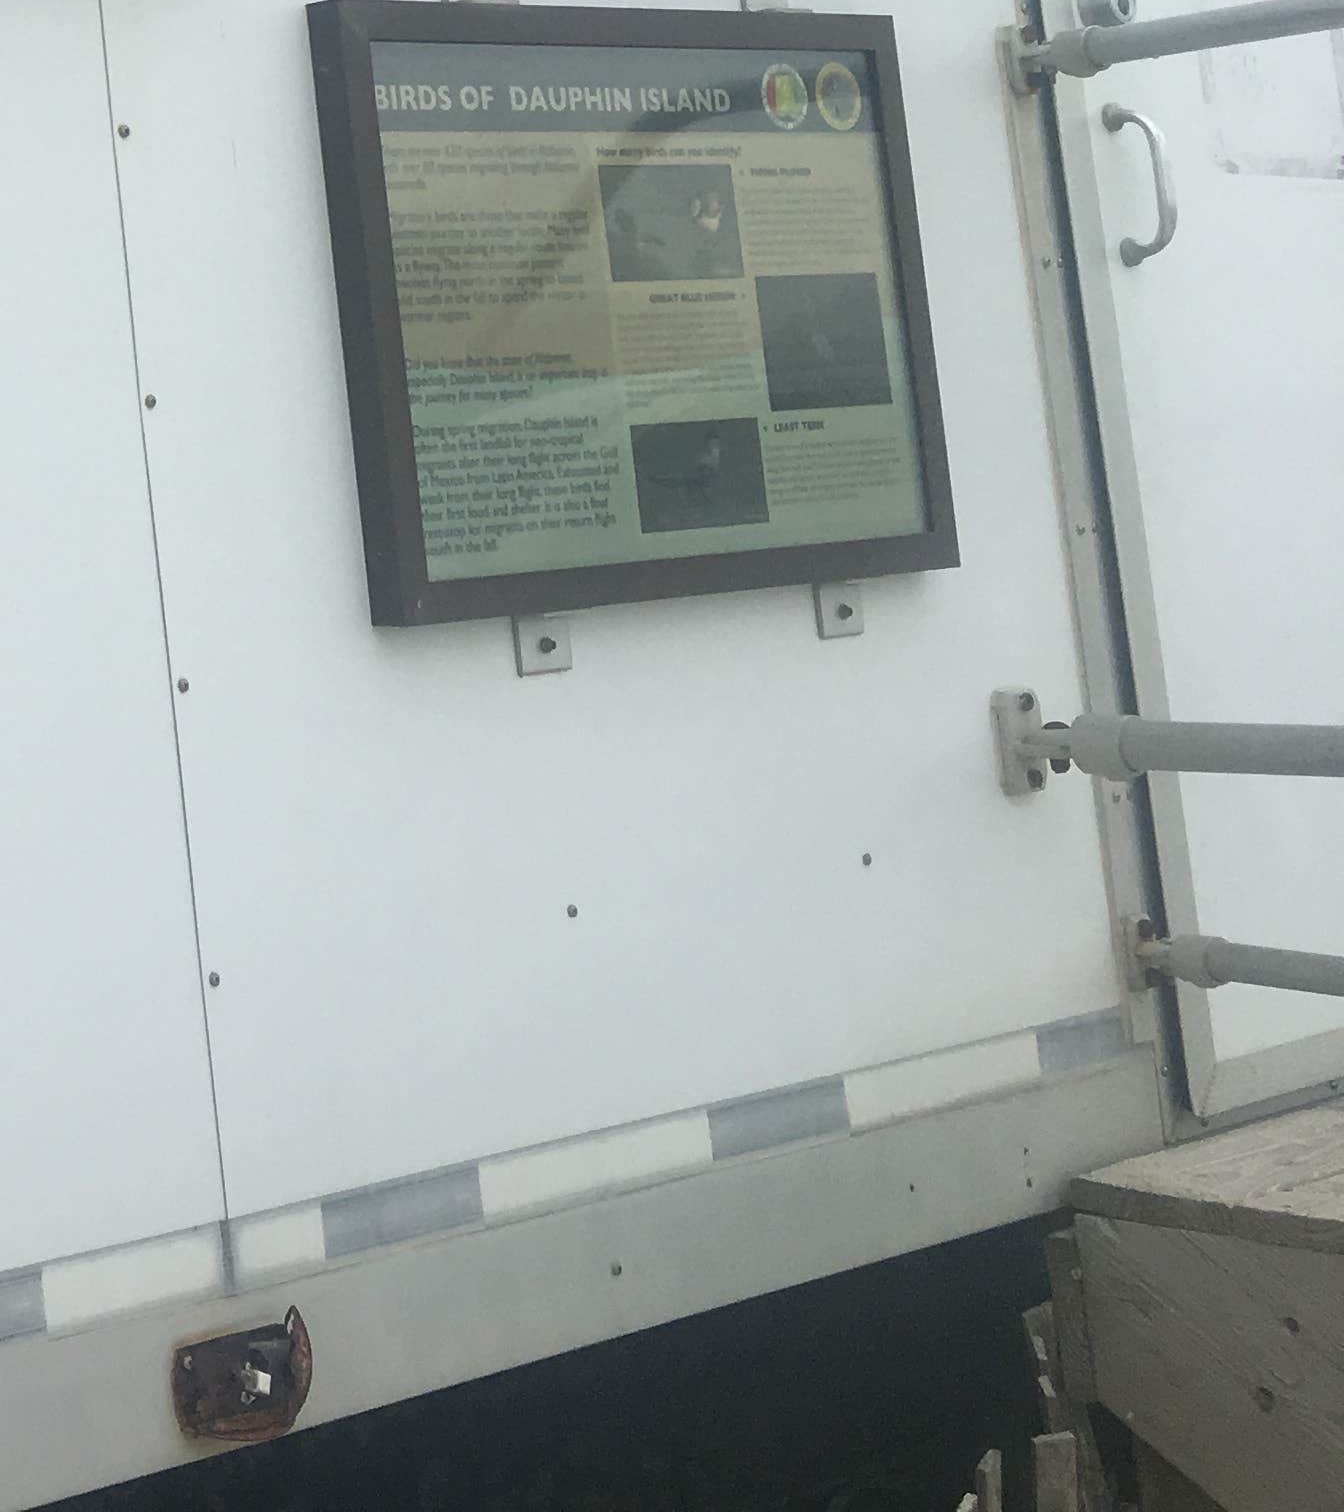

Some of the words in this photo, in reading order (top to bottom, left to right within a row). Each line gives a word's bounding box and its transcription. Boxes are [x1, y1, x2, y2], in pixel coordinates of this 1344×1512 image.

[373, 84, 452, 111] BIRDS
[458, 84, 494, 111] OF
[508, 84, 633, 112] DAUPHIN
[637, 85, 730, 113] ISLAND
